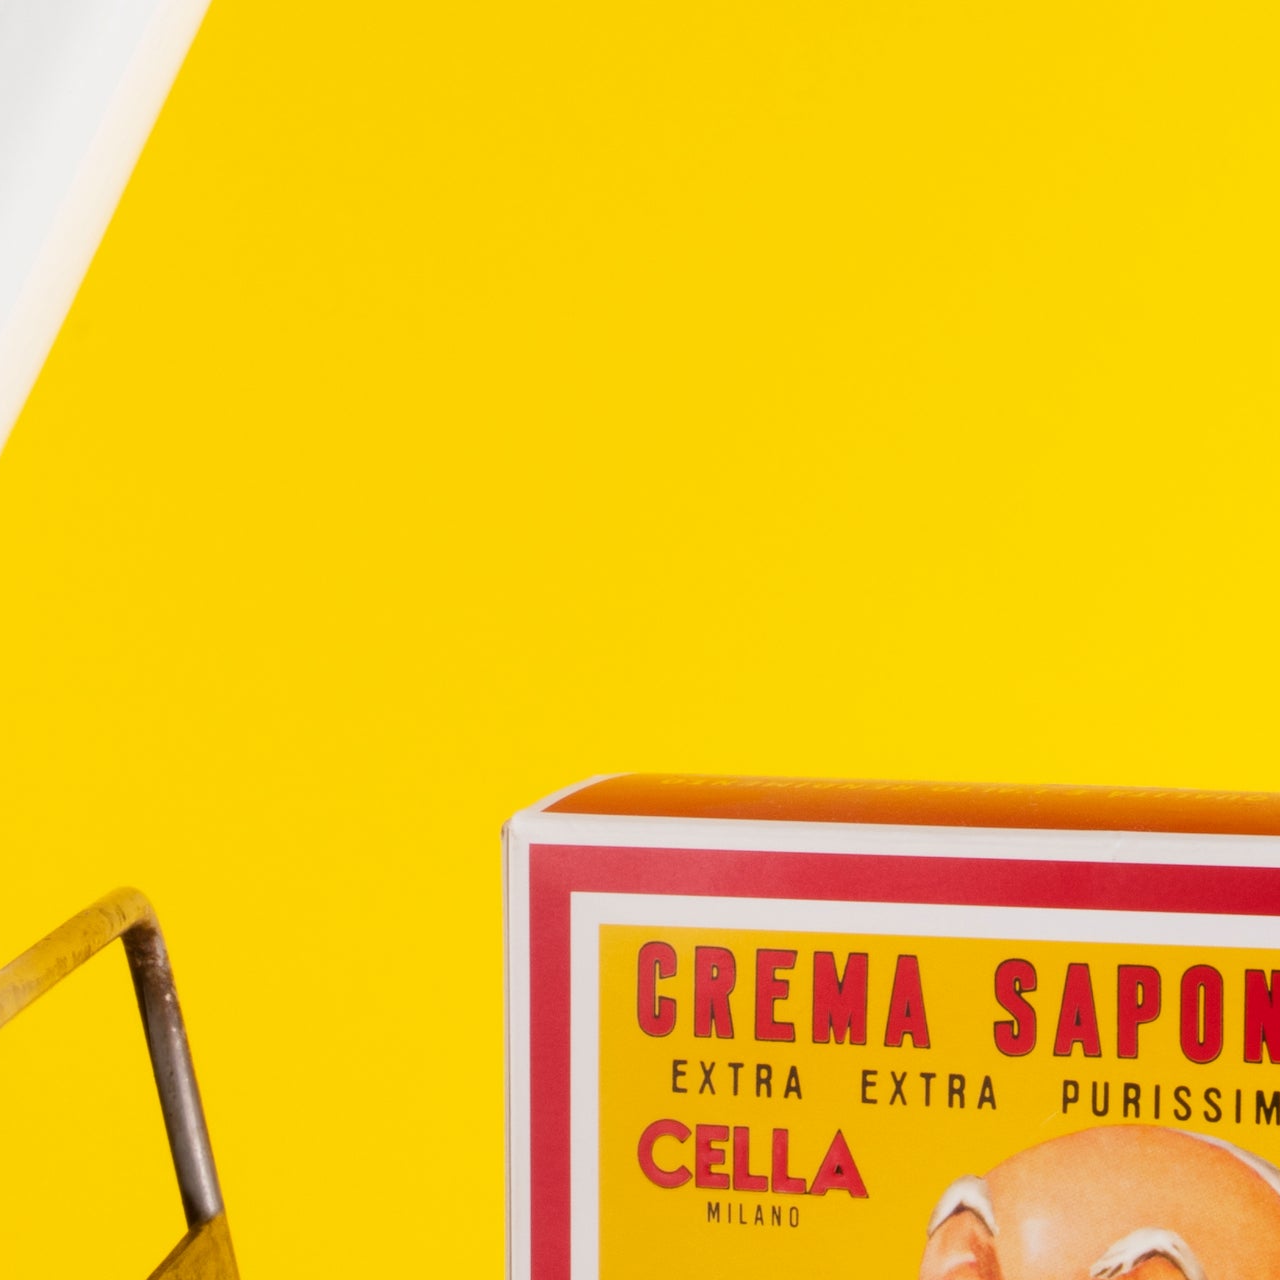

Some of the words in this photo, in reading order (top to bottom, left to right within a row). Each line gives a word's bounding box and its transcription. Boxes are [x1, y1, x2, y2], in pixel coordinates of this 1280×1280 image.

[636, 940, 931, 1049] CREMA
[672, 1058, 803, 1100] EXTRA
[861, 1069, 998, 1111] EXTRA
[636, 1118, 869, 1199] CELLA
[706, 1201, 801, 1229] MILANO
